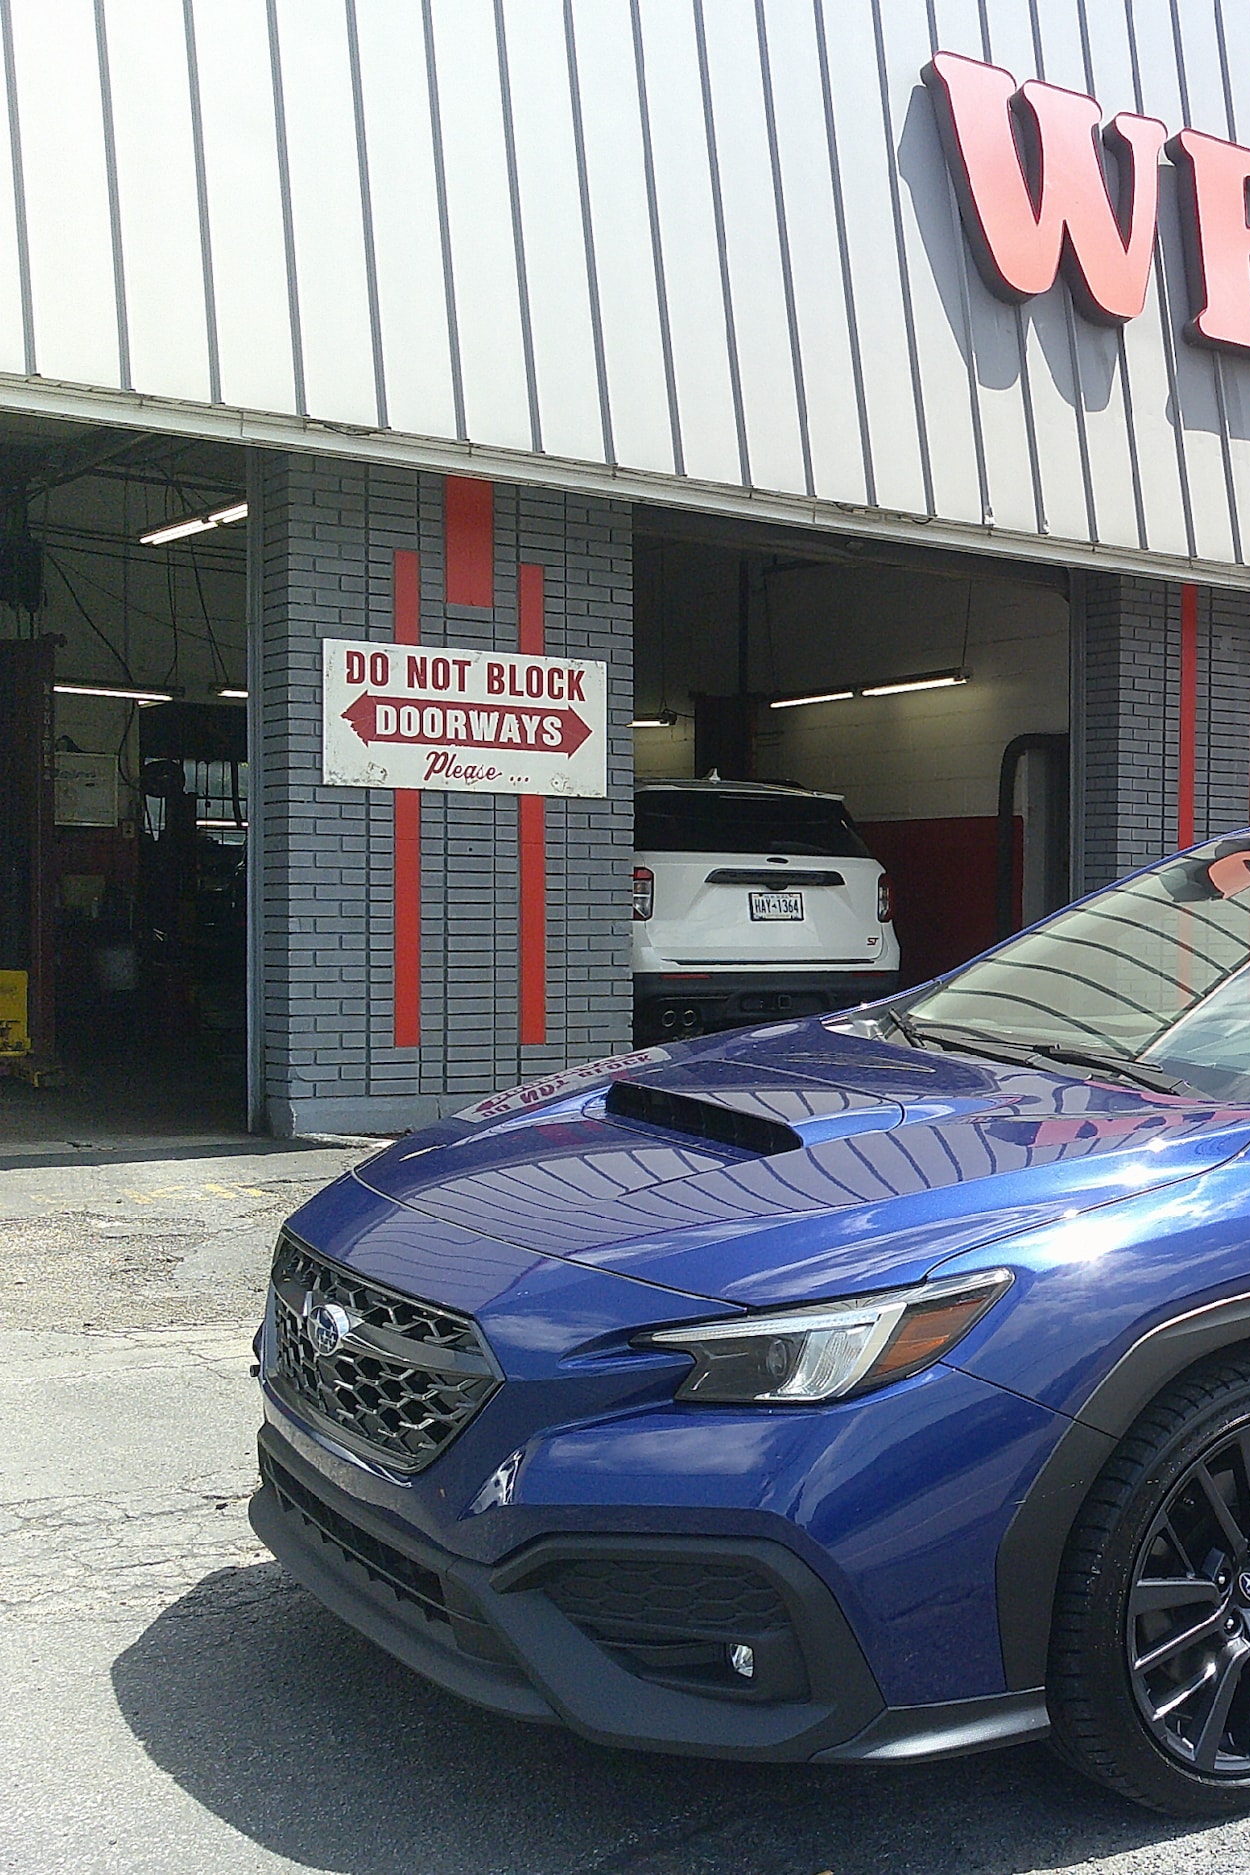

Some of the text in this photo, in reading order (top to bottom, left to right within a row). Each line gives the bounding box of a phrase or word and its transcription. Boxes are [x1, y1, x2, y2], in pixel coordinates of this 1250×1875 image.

[346, 651, 586, 702] DO NOT BLOCK
[375, 704, 564, 747] DOORWAYS
[424, 751, 503, 781] Please
